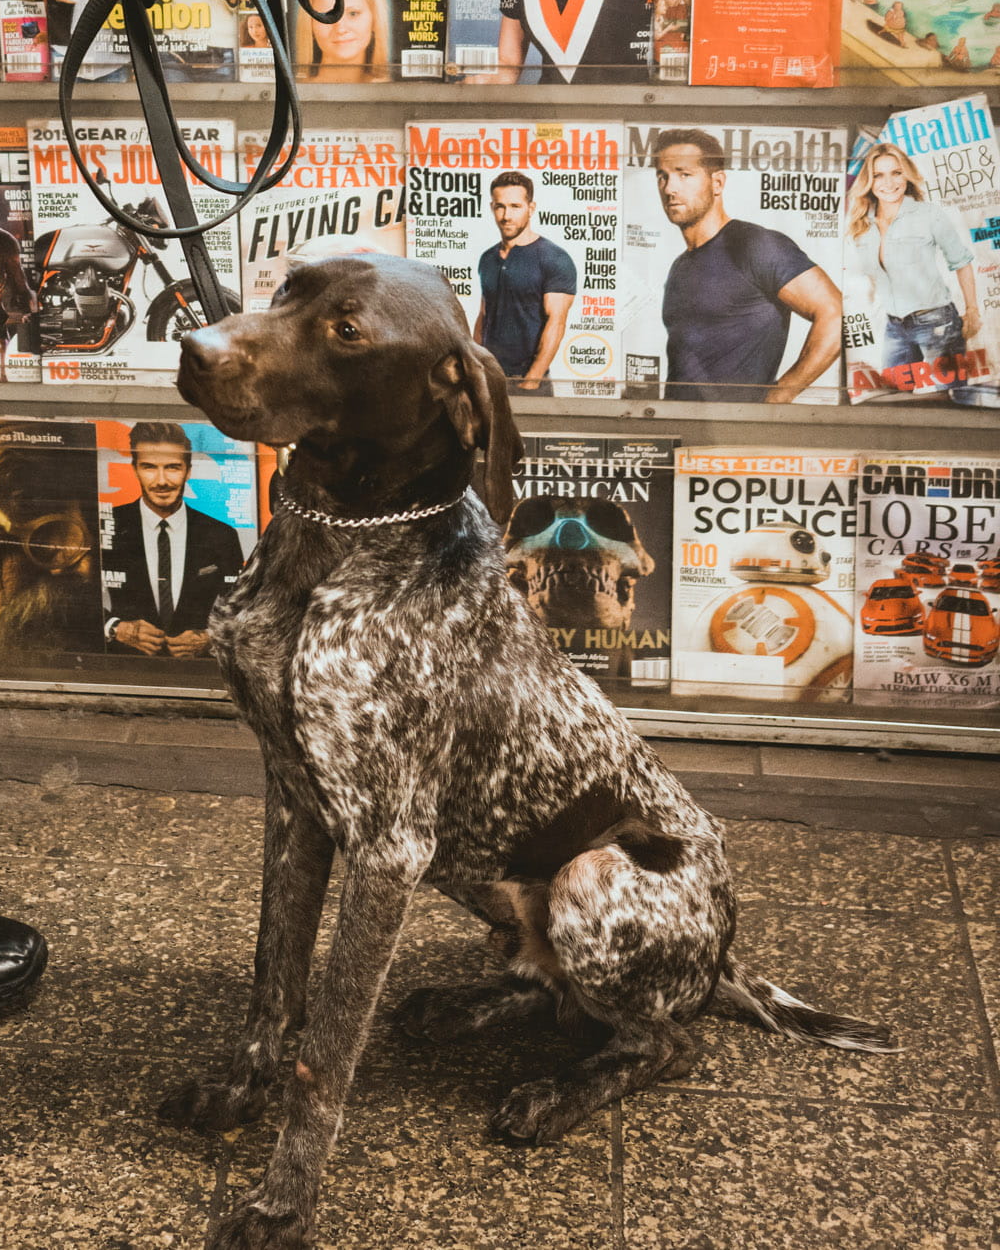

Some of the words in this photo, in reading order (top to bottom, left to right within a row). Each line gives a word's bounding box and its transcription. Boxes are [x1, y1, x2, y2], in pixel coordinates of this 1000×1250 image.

[410, 2, 419, 11] IN
[420, 1, 437, 11] HER
[402, 11, 444, 22] HAUNTING
[413, 22, 433, 32] LAST
[409, 32, 439, 42] WORDS
[75, 128, 127, 141] GEAR
[130, 128, 145, 144] of
[887, 101, 991, 157] Health
[723, 129, 844, 173] Health
[33, 144, 108, 184] MEN'S
[932, 148, 972, 177] HOT
[978, 145, 995, 167] &
[409, 167, 481, 195] Strong
[542, 171, 576, 188] Sleep
[578, 173, 618, 187] Better
[761, 174, 801, 192] Build
[803, 175, 840, 193] Your
[925, 166, 996, 201] HAPPY
[274, 198, 307, 211] FUTURE
[309, 196, 321, 205] OF
[324, 191, 340, 203] THE
[571, 186, 618, 203] Tonight
[760, 192, 797, 210] Best
[799, 194, 840, 213] Body
[408, 193, 425, 217] &
[426, 194, 482, 218] Lean!
[415, 217, 438, 227] Torch
[440, 218, 453, 228] Fat
[539, 211, 586, 228] Women
[588, 212, 618, 227] Love
[248, 196, 361, 263] FLYING
[415, 229, 436, 238] Build
[437, 229, 469, 239] Muscle
[416, 240, 447, 250] Results
[448, 241, 466, 250] That
[586, 248, 617, 262] Build
[585, 262, 617, 277] Huge
[583, 276, 617, 290] Arms
[582, 295, 598, 306] The
[600, 296, 616, 306] Life
[582, 306, 592, 316] of
[593, 306, 616, 317] Ryan
[570, 346, 596, 357] Quads
[597, 345, 606, 355] of
[569, 356, 583, 365] the
[584, 356, 606, 365] Gods
[48, 361, 80, 381] 103
[862, 464, 926, 497] CAR
[859, 500, 911, 540] 10
[682, 544, 718, 568] 100
[868, 538, 953, 559] CARS
[680, 567, 715, 577] GREATEST
[680, 575, 727, 585] INNOVATIONS
[585, 629, 672, 649] HUMAN
[893, 672, 942, 686] BMW
[946, 673, 970, 687] X6
